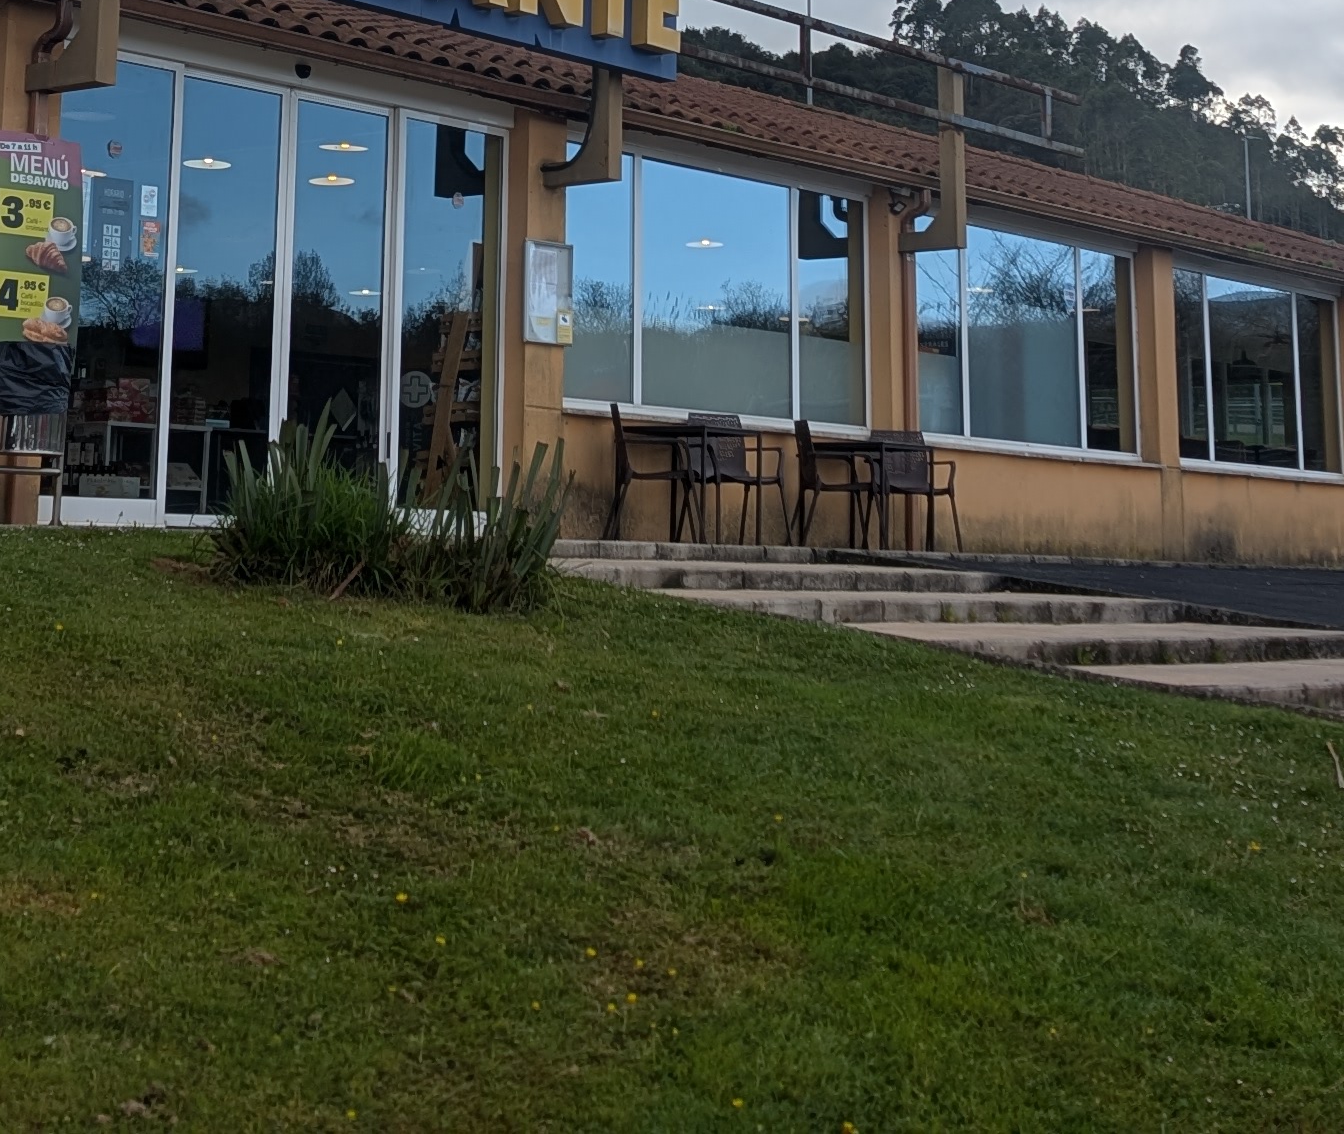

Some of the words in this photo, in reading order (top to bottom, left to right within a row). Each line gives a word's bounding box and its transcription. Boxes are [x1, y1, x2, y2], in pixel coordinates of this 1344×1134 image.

[0, 142, 10, 150] De
[10, 153, 69, 179] MENÚ
[10, 173, 69, 190] DESAYUNO
